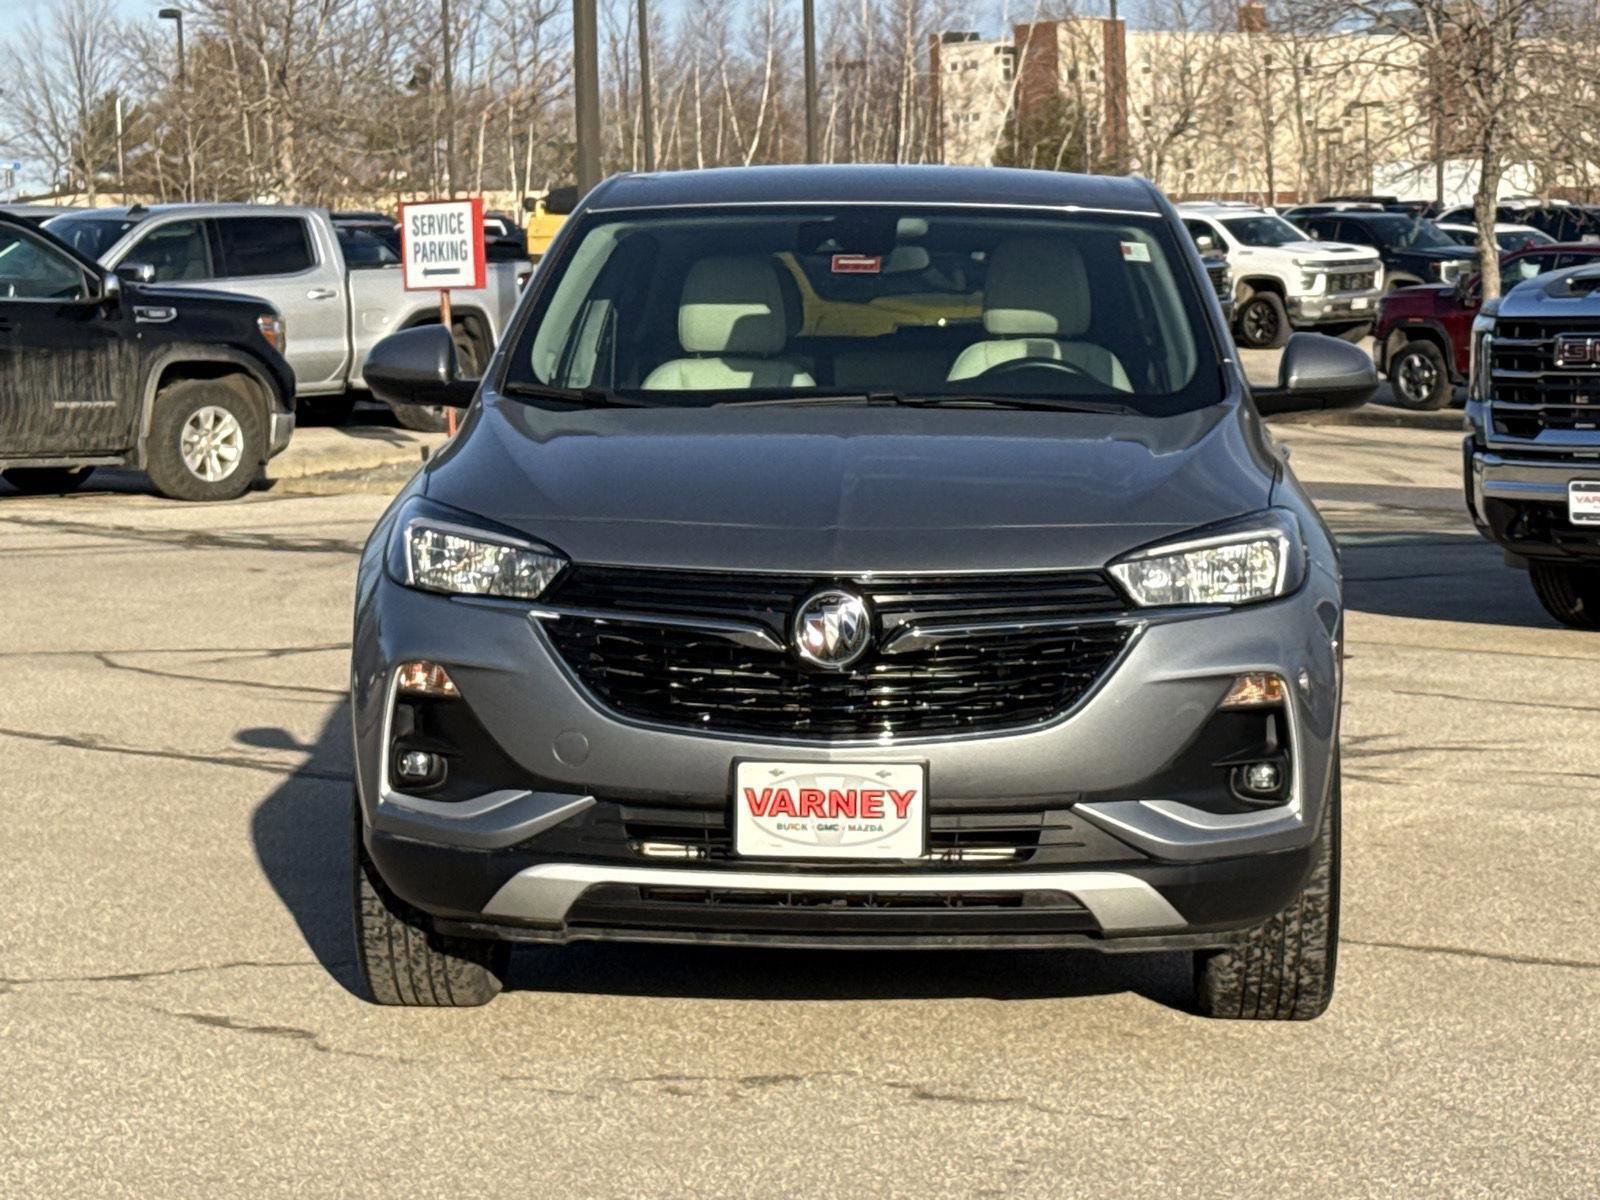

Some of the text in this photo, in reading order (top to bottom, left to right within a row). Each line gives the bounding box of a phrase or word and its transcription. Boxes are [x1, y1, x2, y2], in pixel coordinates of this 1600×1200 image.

[412, 212, 464, 236] SERVICE
[413, 239, 468, 262] PARKING
[743, 787, 917, 818] VARNEY
[776, 822, 884, 832] BUICK GMC MAZDA
